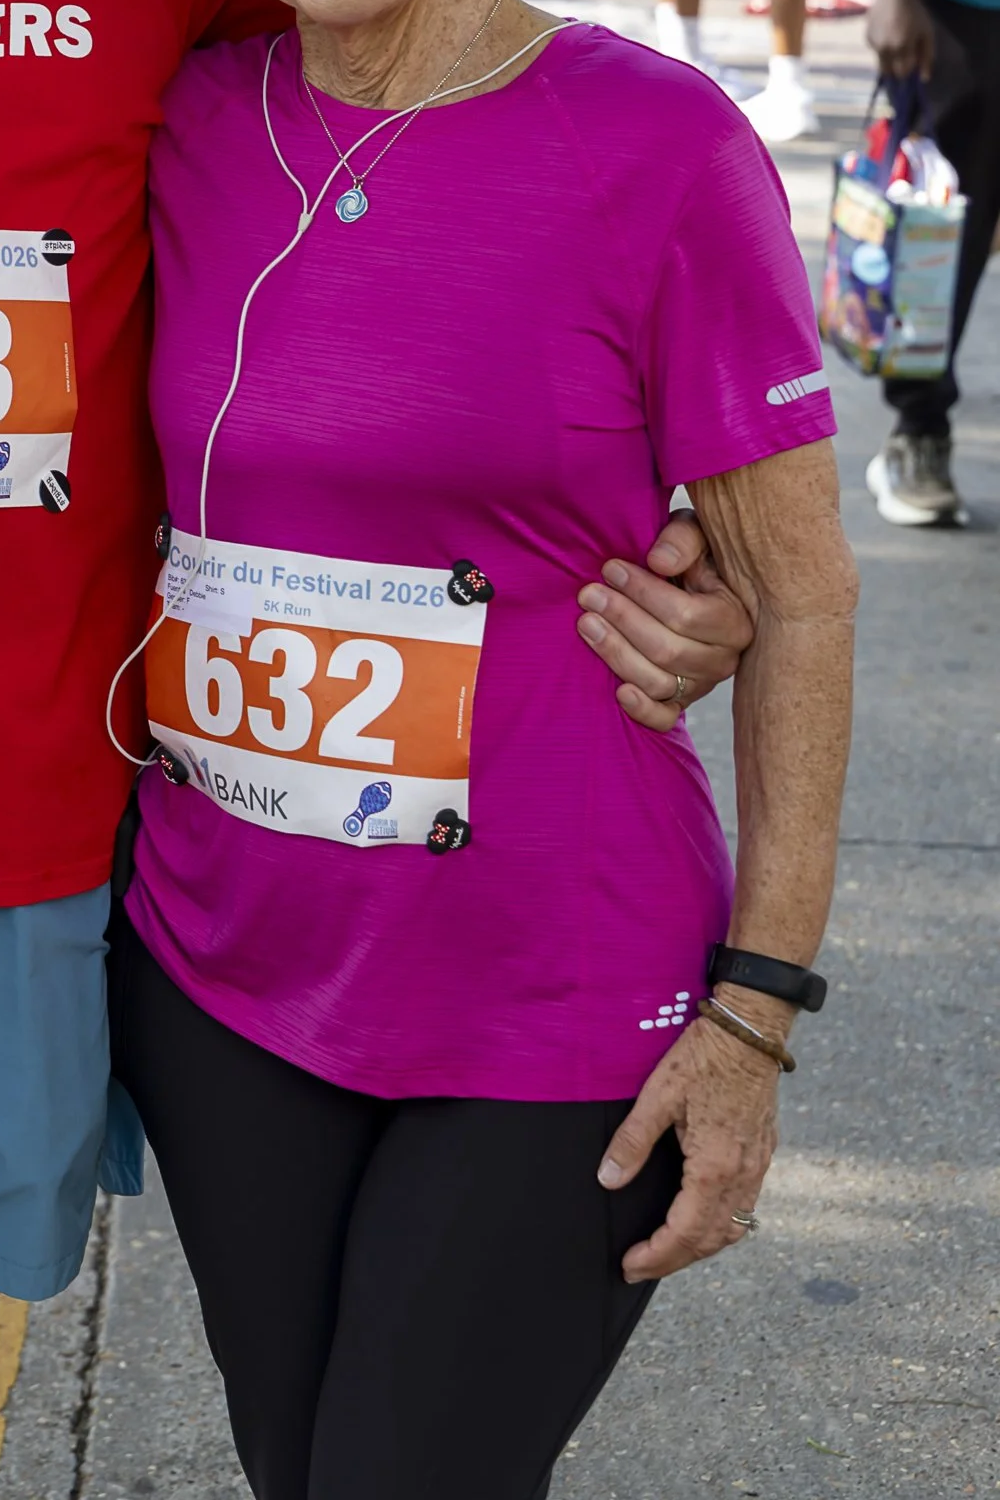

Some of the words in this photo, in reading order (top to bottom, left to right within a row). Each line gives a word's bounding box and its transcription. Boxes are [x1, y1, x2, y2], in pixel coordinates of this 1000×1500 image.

[233, 562, 263, 584] du
[271, 565, 371, 600] Festival
[381, 580, 445, 607] 2026
[264, 600, 279, 613] 5K
[284, 604, 311, 617] Run
[184, 624, 404, 766] 632
